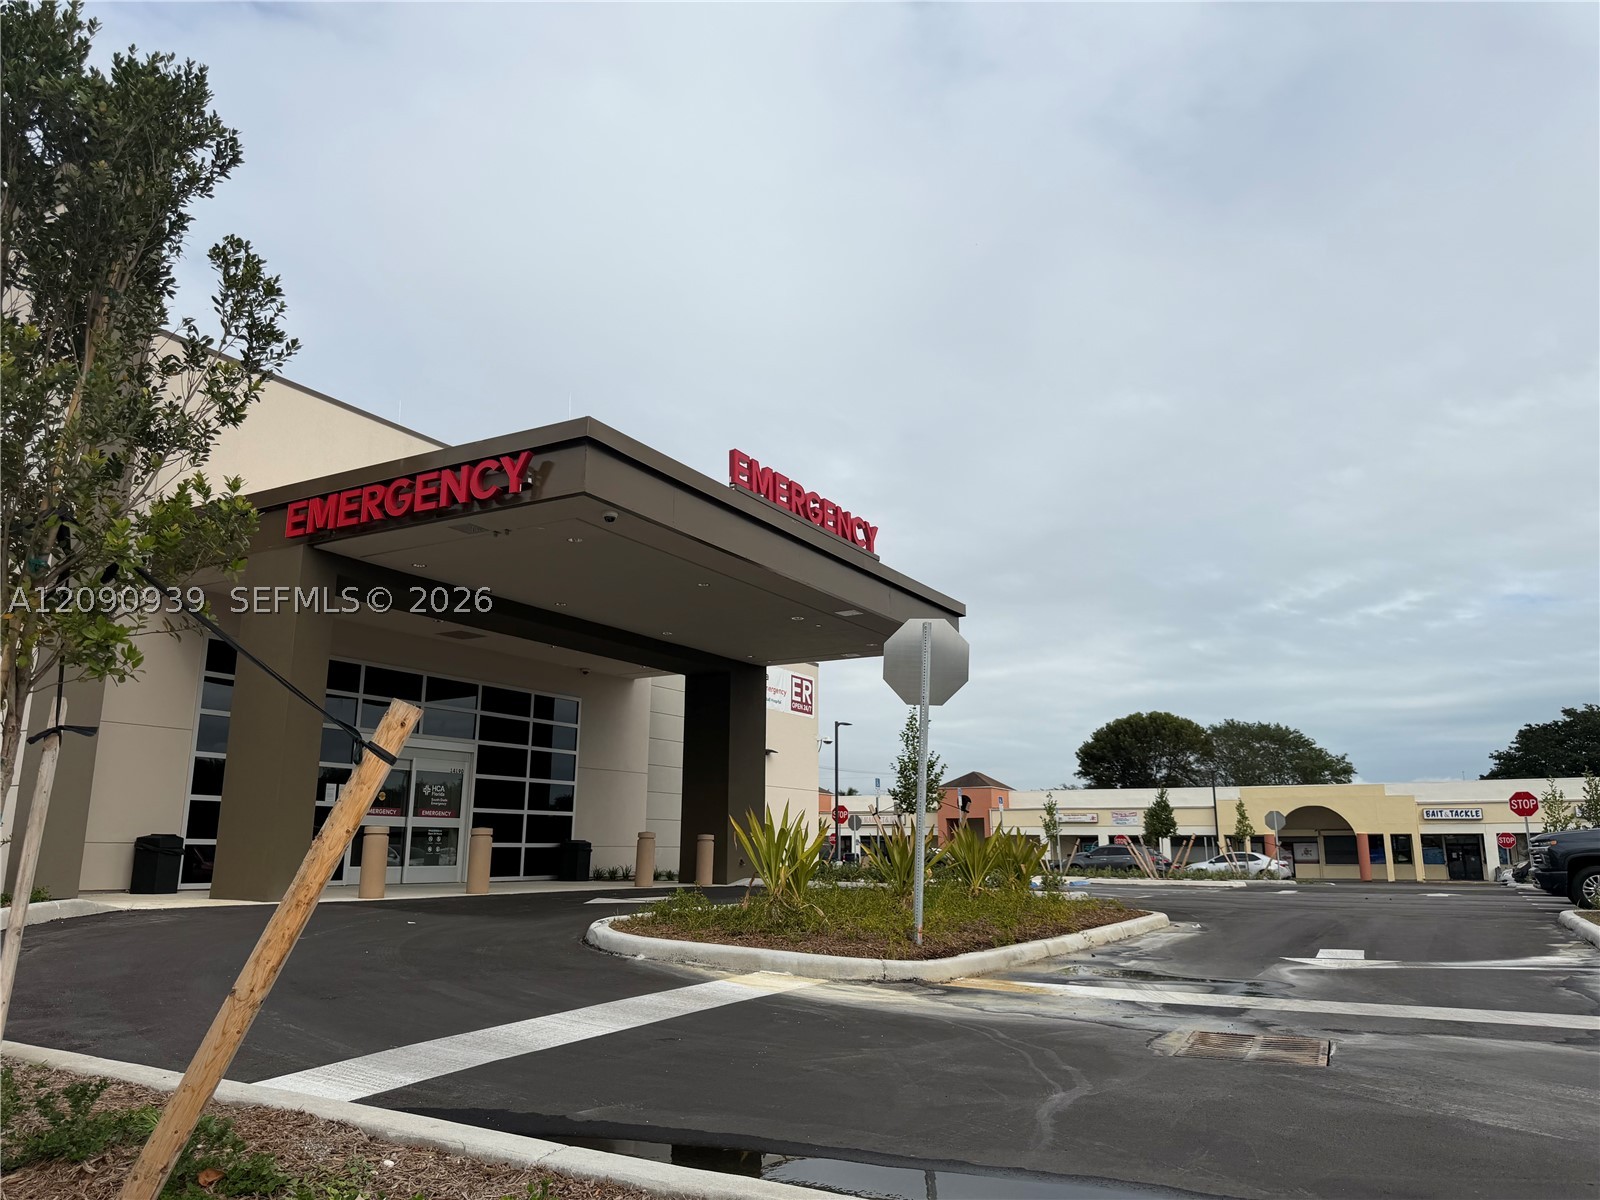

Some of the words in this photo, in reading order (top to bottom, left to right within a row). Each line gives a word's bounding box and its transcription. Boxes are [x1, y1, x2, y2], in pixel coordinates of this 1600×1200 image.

[285, 451, 534, 538] EMERGENCY
[729, 448, 878, 554] EMERGENCY
[792, 678, 812, 704] ER
[803, 705, 812, 713] 24/7
[1511, 798, 1537, 810] STOP
[1425, 810, 1443, 818] BAIT
[1450, 810, 1480, 818] TACKLE
[1498, 835, 1515, 844] STOP
